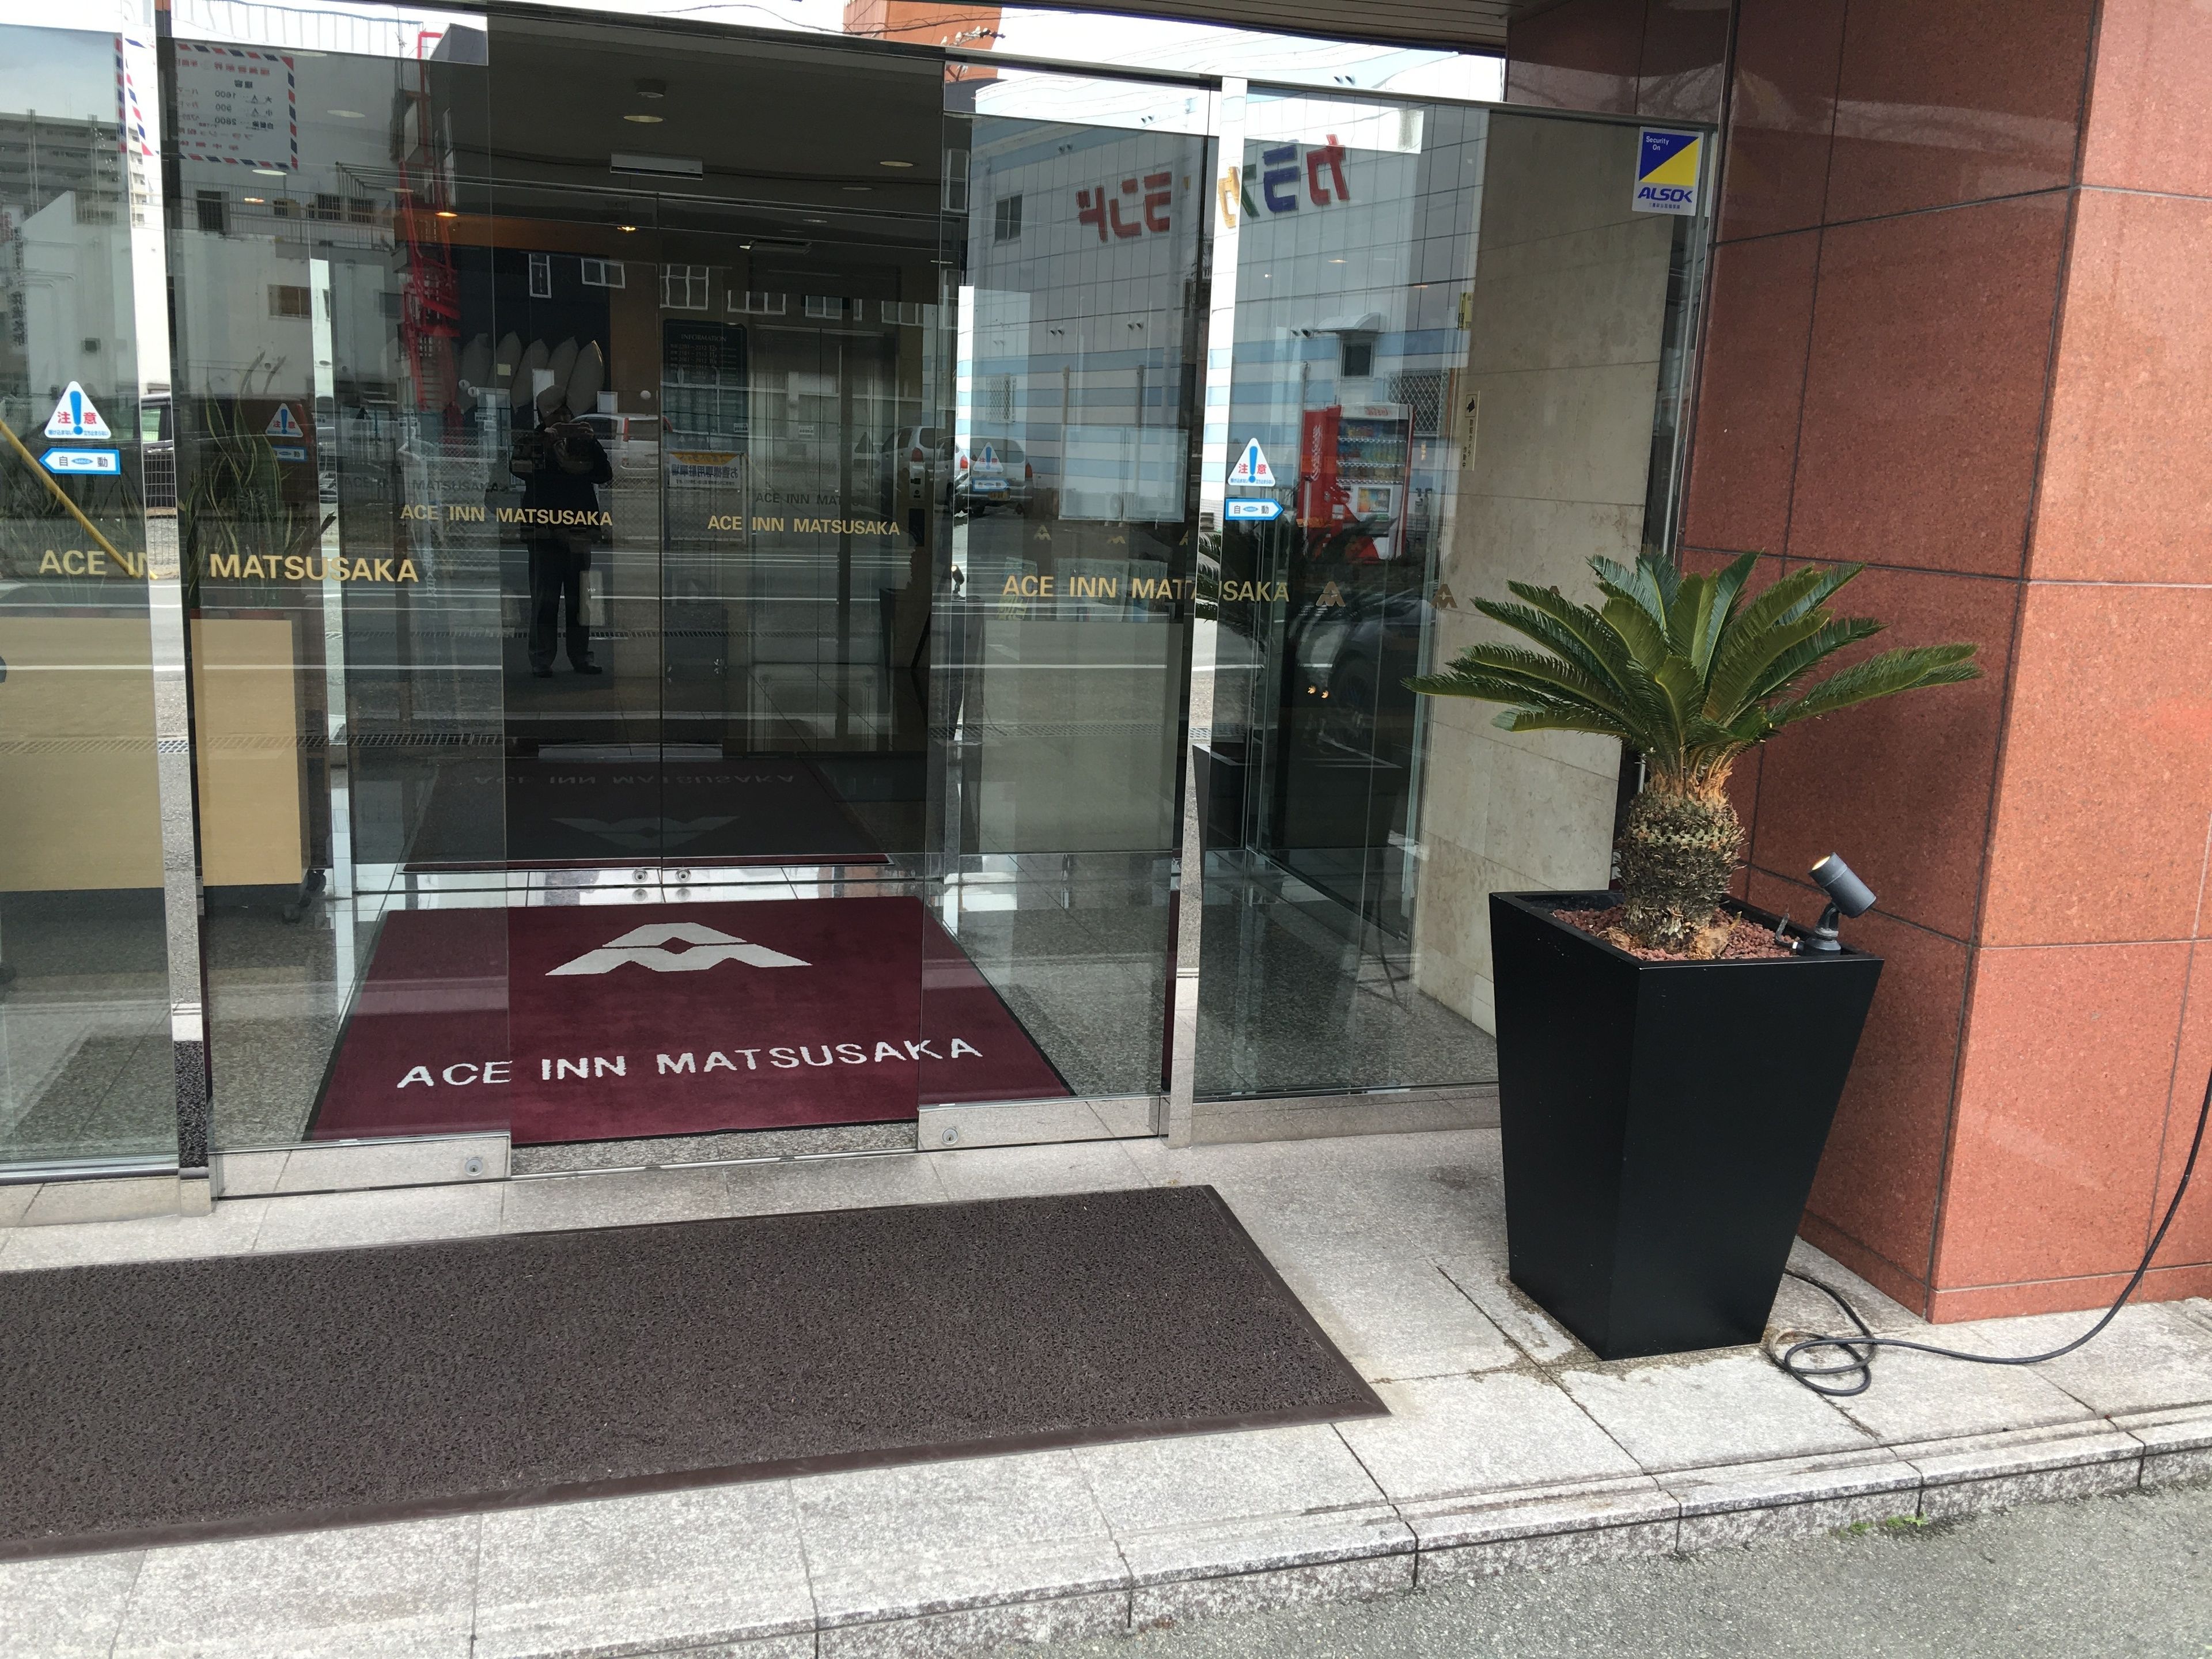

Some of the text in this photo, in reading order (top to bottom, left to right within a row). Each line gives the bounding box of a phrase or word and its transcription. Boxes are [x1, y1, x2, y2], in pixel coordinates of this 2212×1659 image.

[1645, 135, 1669, 146] Security
[1637, 187, 1694, 203] ALSOK
[681, 334, 727, 342] INFORMATION
[58, 411, 97, 424] 注 意
[1238, 464, 1267, 474] 注 意
[400, 504, 613, 527] ACE INN MATSUSAKA
[707, 515, 900, 536] ACE INN MATSUSAKA
[39, 550, 107, 575] ACE
[210, 553, 419, 584] MATSUSAKA
[1002, 575, 1054, 597] ACE
[1069, 576, 1117, 599] INN
[396, 1037, 983, 1089] ACE INN MATSUSAKA
